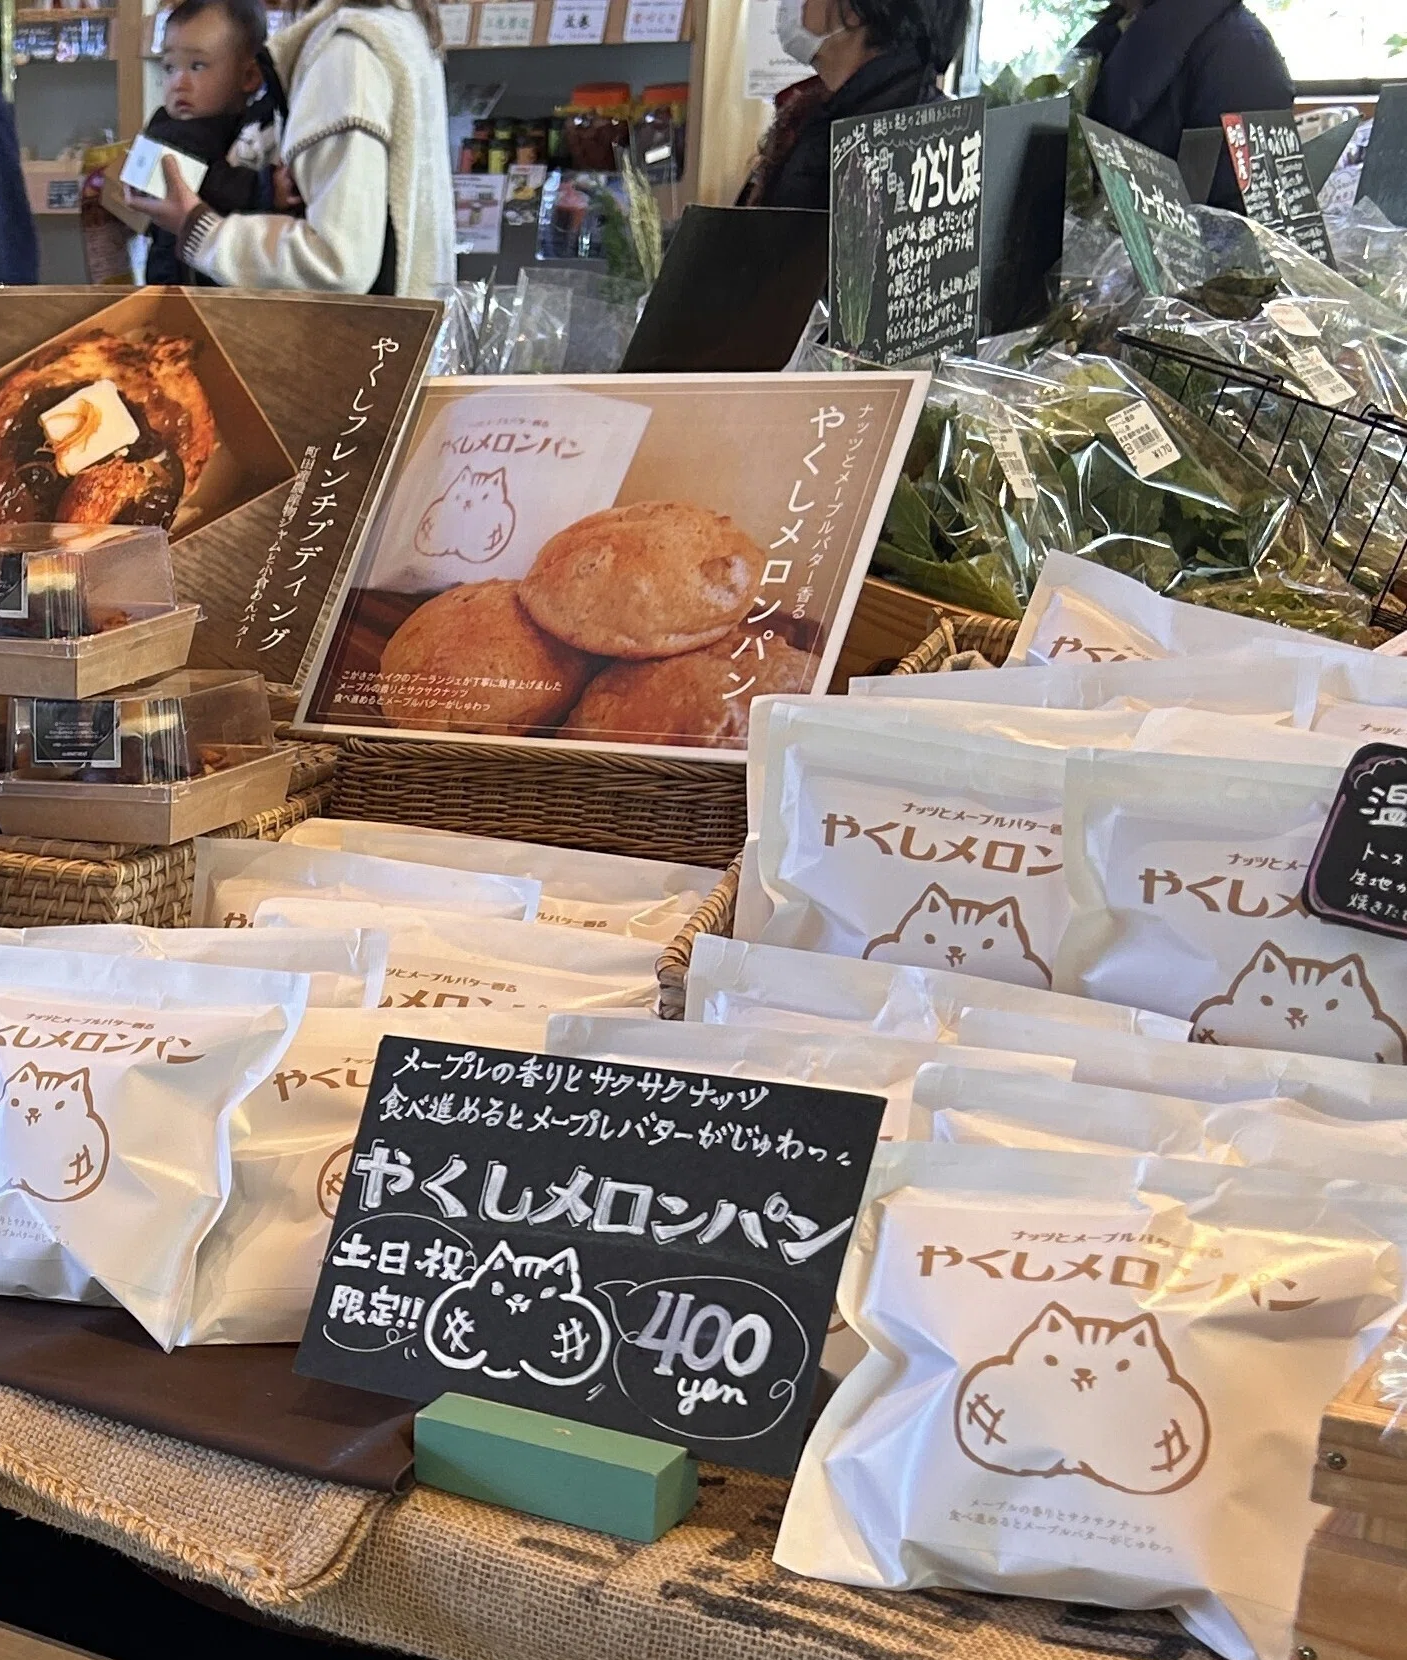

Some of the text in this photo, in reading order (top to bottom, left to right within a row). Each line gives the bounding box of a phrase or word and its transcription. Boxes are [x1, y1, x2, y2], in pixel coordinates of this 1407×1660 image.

[909, 130, 982, 212] からし菜
[257, 336, 400, 652] やくしフレンチプディング
[792, 403, 874, 619] ナッツとメープルバター香る
[722, 405, 845, 700] やくしメロンパン
[393, 1046, 769, 1112] メープルの香りとサクサクナッツ
[351, 1138, 855, 1266] やくしメロンパン
[633, 1289, 773, 1377] 400
[676, 1376, 747, 1416] yen
